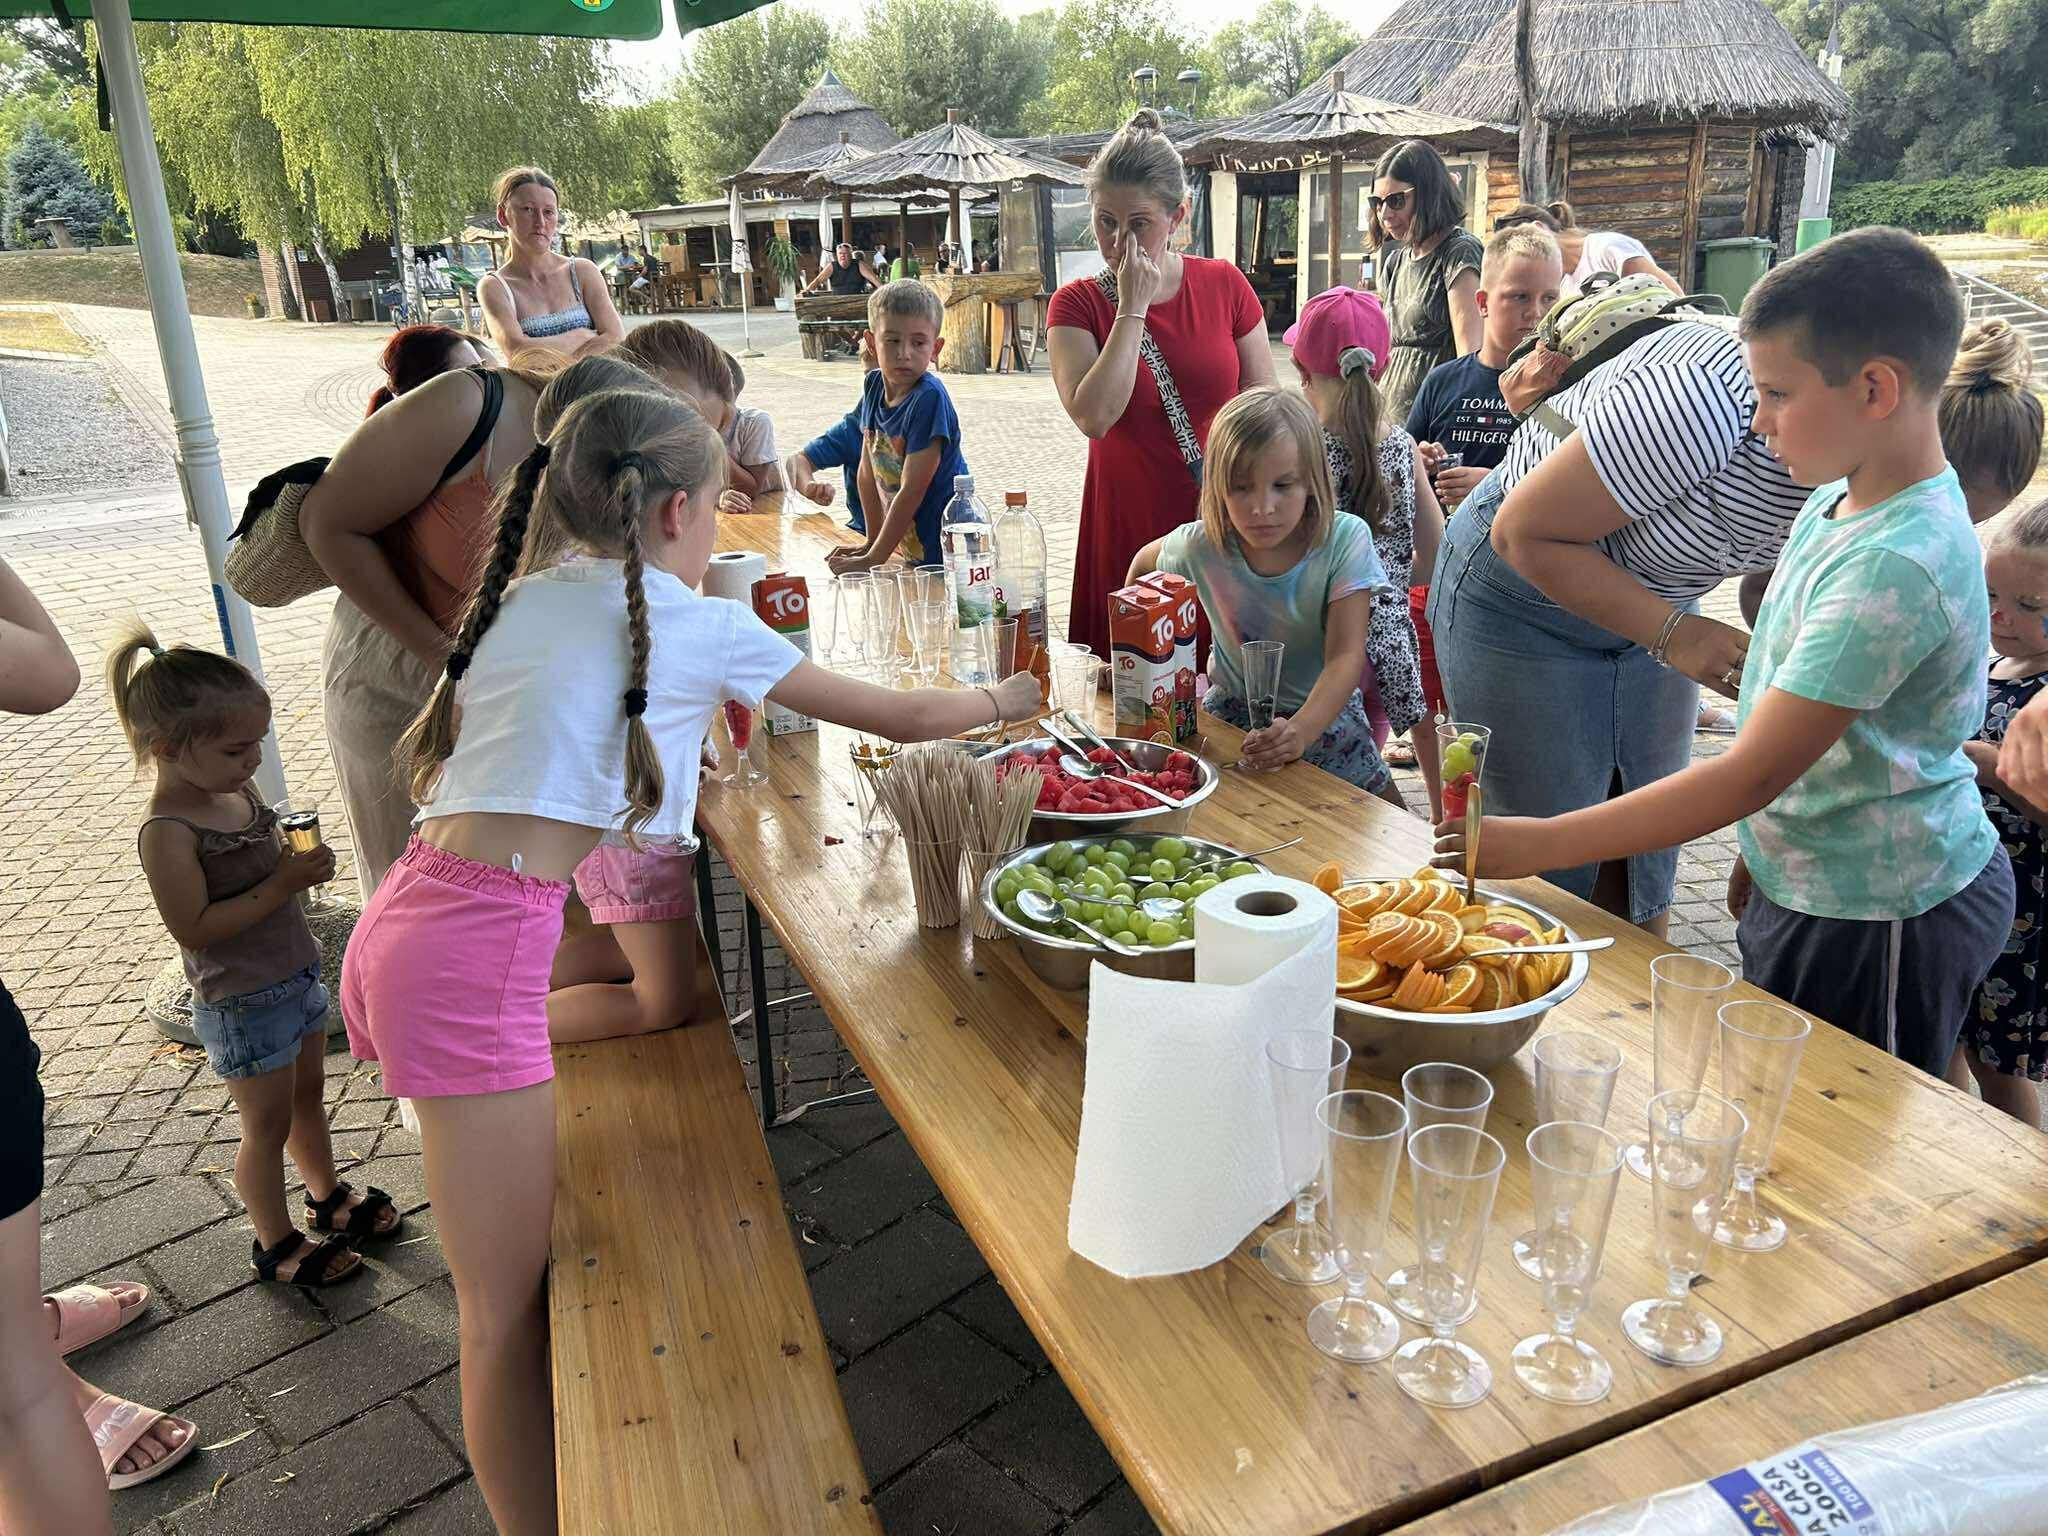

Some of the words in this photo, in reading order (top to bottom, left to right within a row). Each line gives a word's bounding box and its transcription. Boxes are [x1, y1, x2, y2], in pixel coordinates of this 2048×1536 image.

[1461, 398, 1508, 410] TOMM
[1495, 417, 1512, 425] 1985
[1452, 430, 1508, 445] HILFIGER
[1812, 1456, 1843, 1485] kom
[1784, 1458, 1849, 1527] 200cc
[1838, 1485, 1865, 1512] 100
